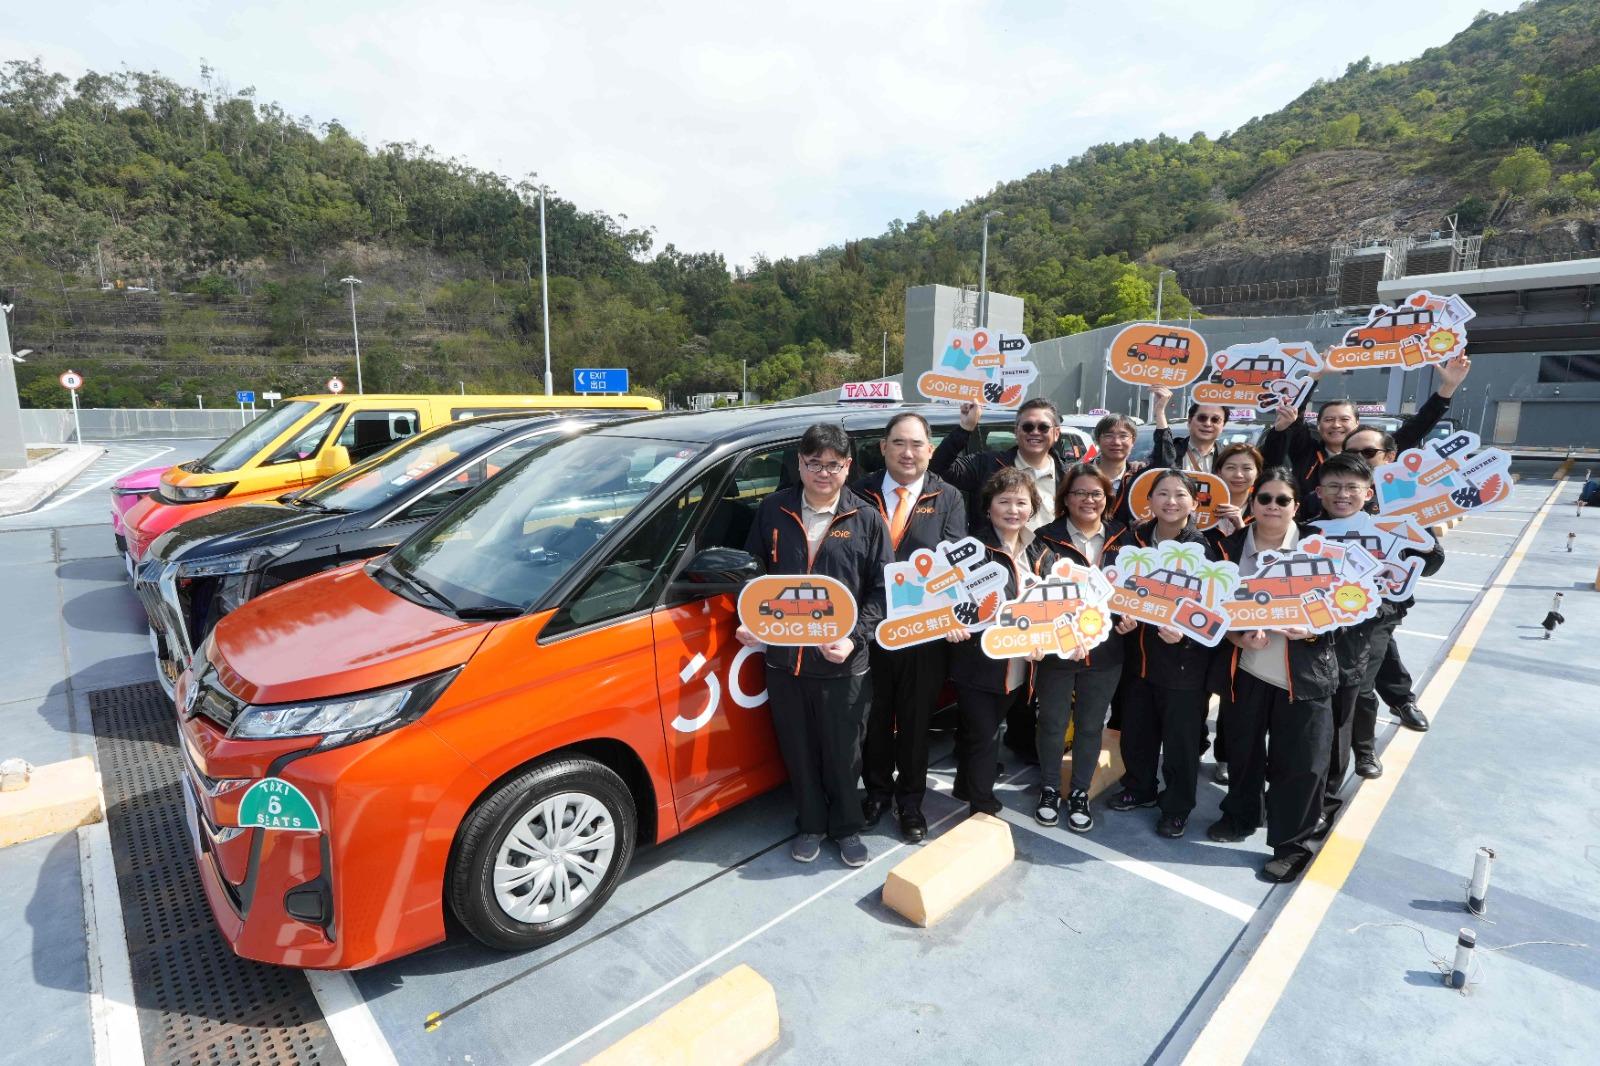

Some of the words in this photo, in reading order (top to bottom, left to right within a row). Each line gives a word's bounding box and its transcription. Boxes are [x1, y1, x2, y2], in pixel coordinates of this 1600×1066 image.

[590, 371, 607, 380] EXIT
[1161, 367, 1187, 381] 樂行
[590, 381, 606, 389] 出口
[845, 383, 890, 398] TAXI
[1462, 455, 1498, 478] TOGETHER
[1421, 501, 1449, 519] 樂行
[950, 546, 974, 561] let's
[931, 573, 958, 590] travel
[965, 571, 998, 591] TOGETHER
[1112, 593, 1140, 610] oie
[1141, 601, 1169, 618] 樂行
[1271, 606, 1299, 619] 樂行
[807, 622, 838, 637] 樂行
[926, 614, 952, 632] 樂行
[259, 780, 290, 796] TAXI
[268, 795, 282, 815] 6
[256, 813, 302, 827] SEATS
